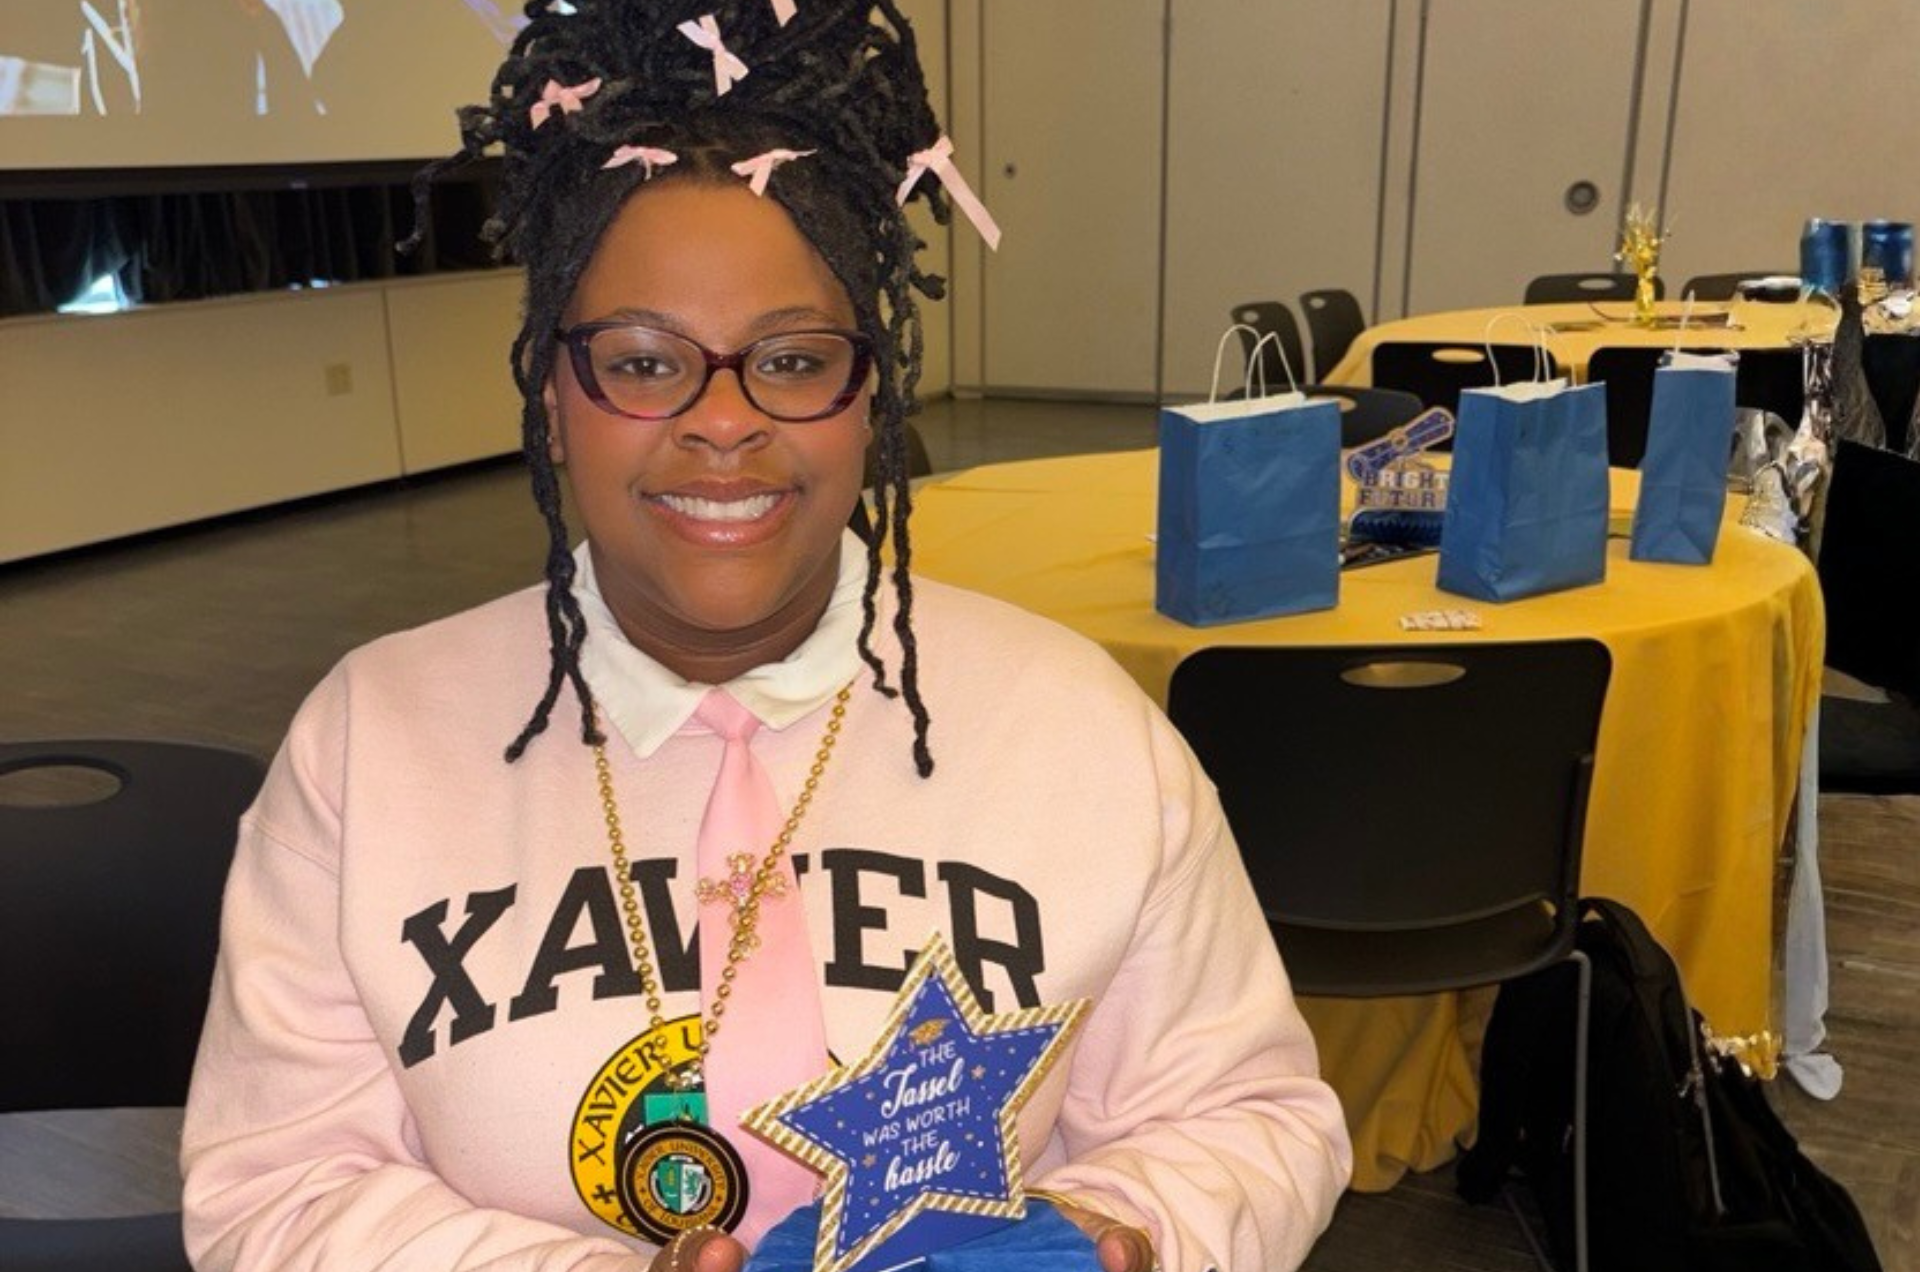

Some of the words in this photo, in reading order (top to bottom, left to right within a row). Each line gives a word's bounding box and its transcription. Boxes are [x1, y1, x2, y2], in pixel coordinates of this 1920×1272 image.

[1359, 489, 1443, 508] FUTUR
[397, 848, 1045, 1069] XAVER
[918, 1040, 957, 1068] THE
[881, 1057, 965, 1119] Tassel
[862, 1122, 900, 1147] WAS
[906, 1096, 971, 1133] WORTH
[901, 1130, 940, 1156] THE
[884, 1140, 961, 1192] hassle
